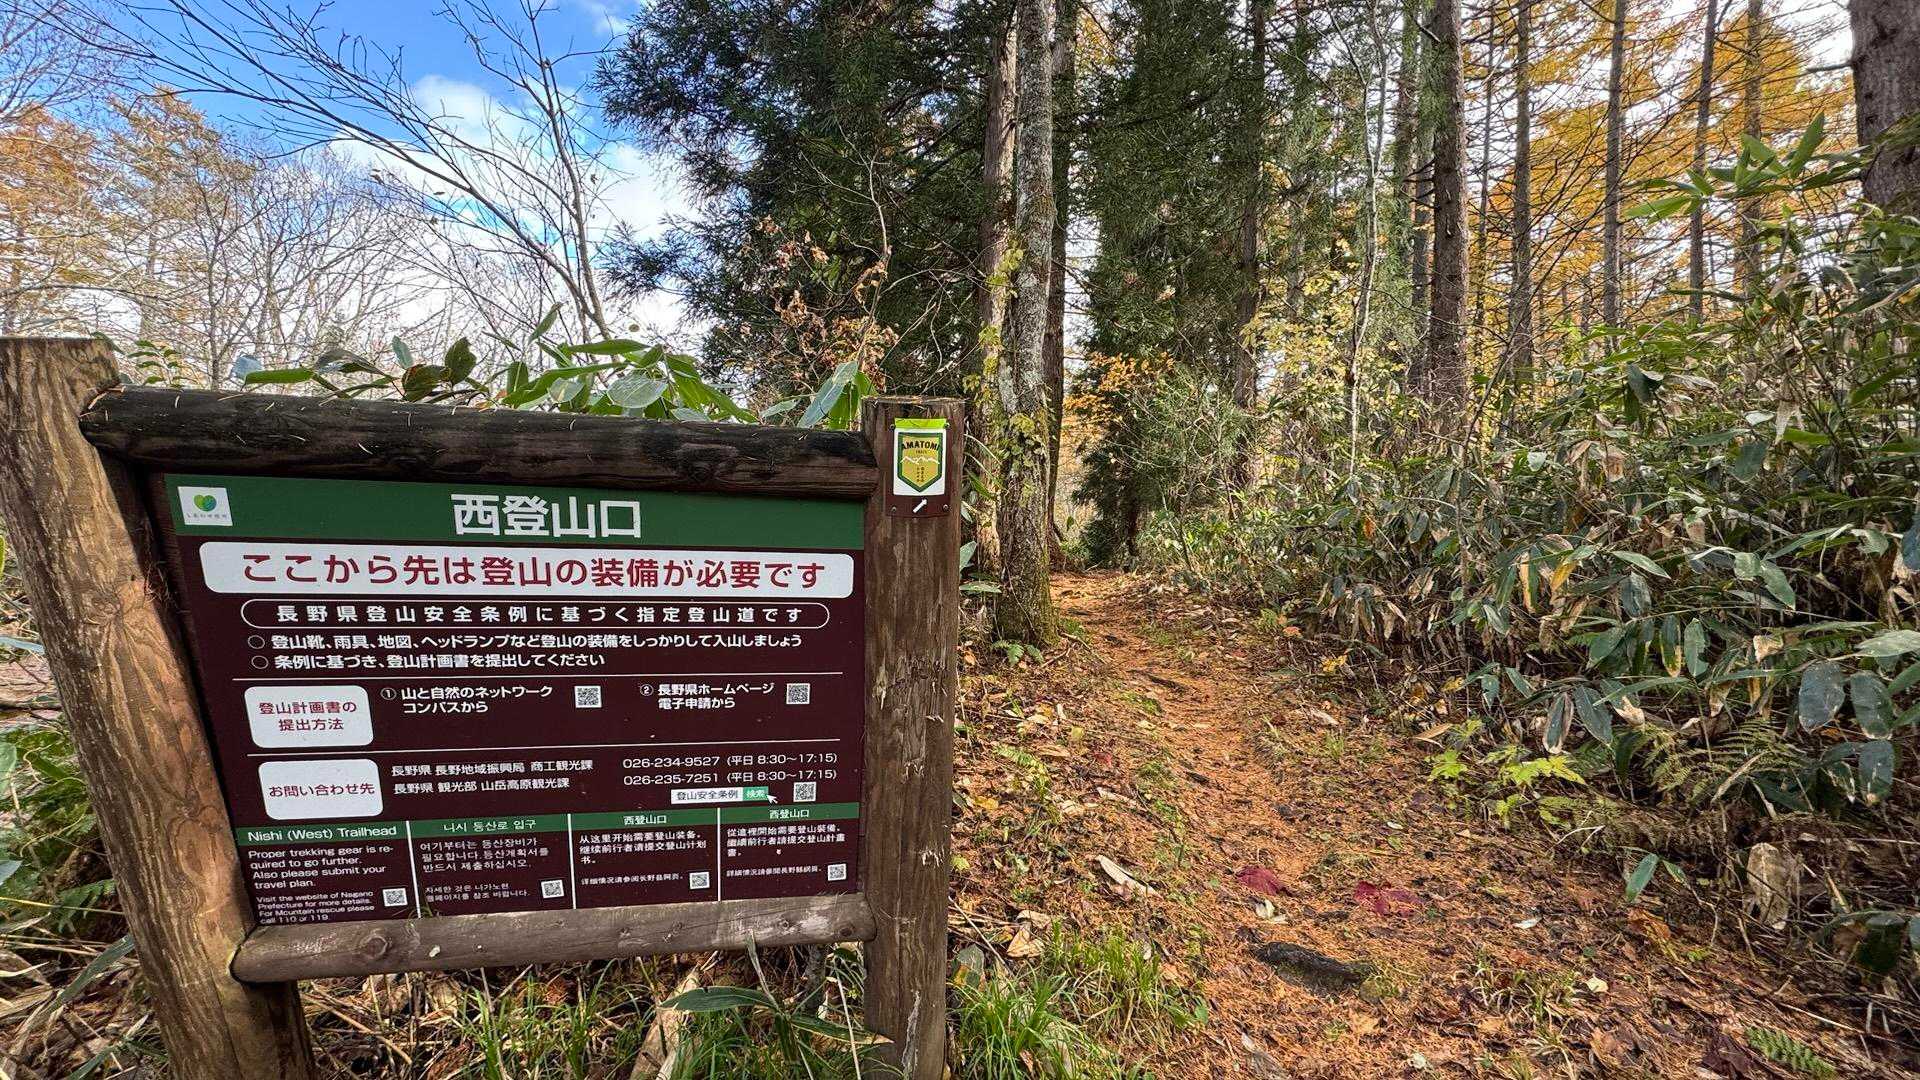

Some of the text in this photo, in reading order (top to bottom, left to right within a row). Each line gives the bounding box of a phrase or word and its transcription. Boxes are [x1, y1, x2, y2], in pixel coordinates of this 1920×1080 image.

[451, 493, 641, 539] 西登山口
[242, 554, 826, 589] ここから先は登山の装備が必要です
[658, 682, 775, 696] 長野県ホームページ
[259, 701, 357, 715] 登山計画書の
[402, 701, 489, 715] コンパスから
[658, 696, 736, 710] 電子申請から
[278, 718, 344, 732] 提出方法
[622, 756, 720, 769] 026-234-9527
[623, 773, 719, 785] 026-235-7251
[269, 783, 375, 798] お問い合わせ先
[623, 814, 667, 826] 西登山口
[769, 808, 810, 819] 西登山口
[443, 819, 537, 833] 니시 등산로 입구
[248, 826, 397, 842] Nishi (West) Trailhead
[420, 837, 538, 851] 여기부터는 등산장비가
[248, 849, 286, 860] Proper
[290, 847, 335, 857] trekking
[338, 846, 363, 856] gear
[365, 845, 376, 853] is
[250, 857, 362, 871] quired to go further.
[422, 862, 456, 873] 반드시
[252, 865, 387, 880] Also please submit your
[254, 879, 316, 890] travel plan.
[256, 895, 276, 903] Visit
[279, 894, 293, 902] the
[296, 893, 328, 901] website
[340, 890, 374, 899] Nagano
[257, 901, 303, 911] Prefecture
[305, 900, 317, 908] for
[275, 908, 315, 917] Mountain
[316, 906, 346, 914] rescue
[347, 904, 375, 913] please
[279, 915, 297, 924] 110
